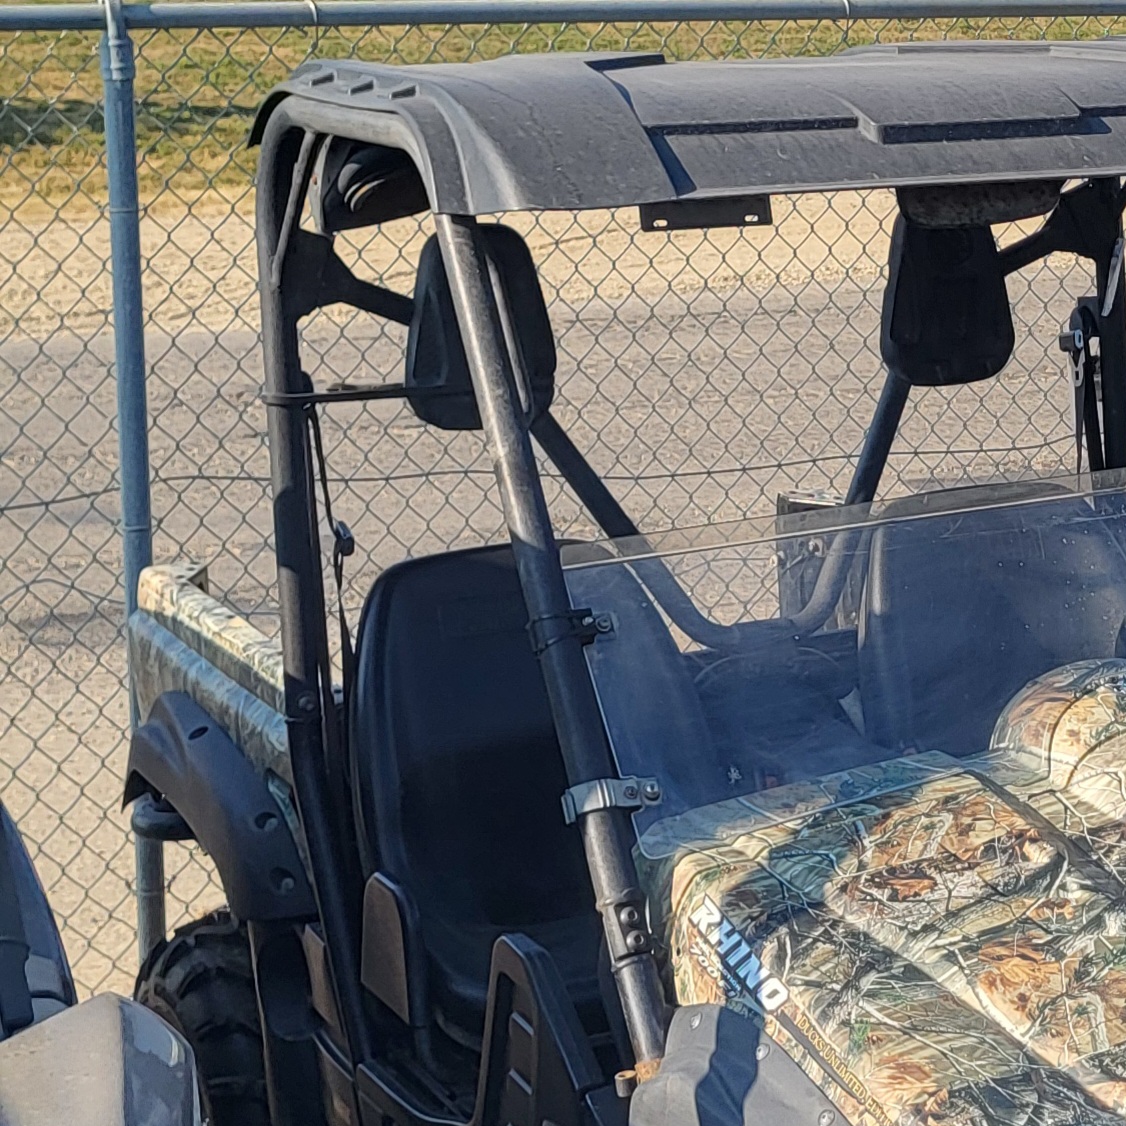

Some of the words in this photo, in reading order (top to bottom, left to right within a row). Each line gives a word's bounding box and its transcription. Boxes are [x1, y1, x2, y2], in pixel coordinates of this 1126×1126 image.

[689, 893, 789, 1013] RHINO
[690, 944, 719, 979] 700
[797, 1014, 826, 1050] DUCKS
